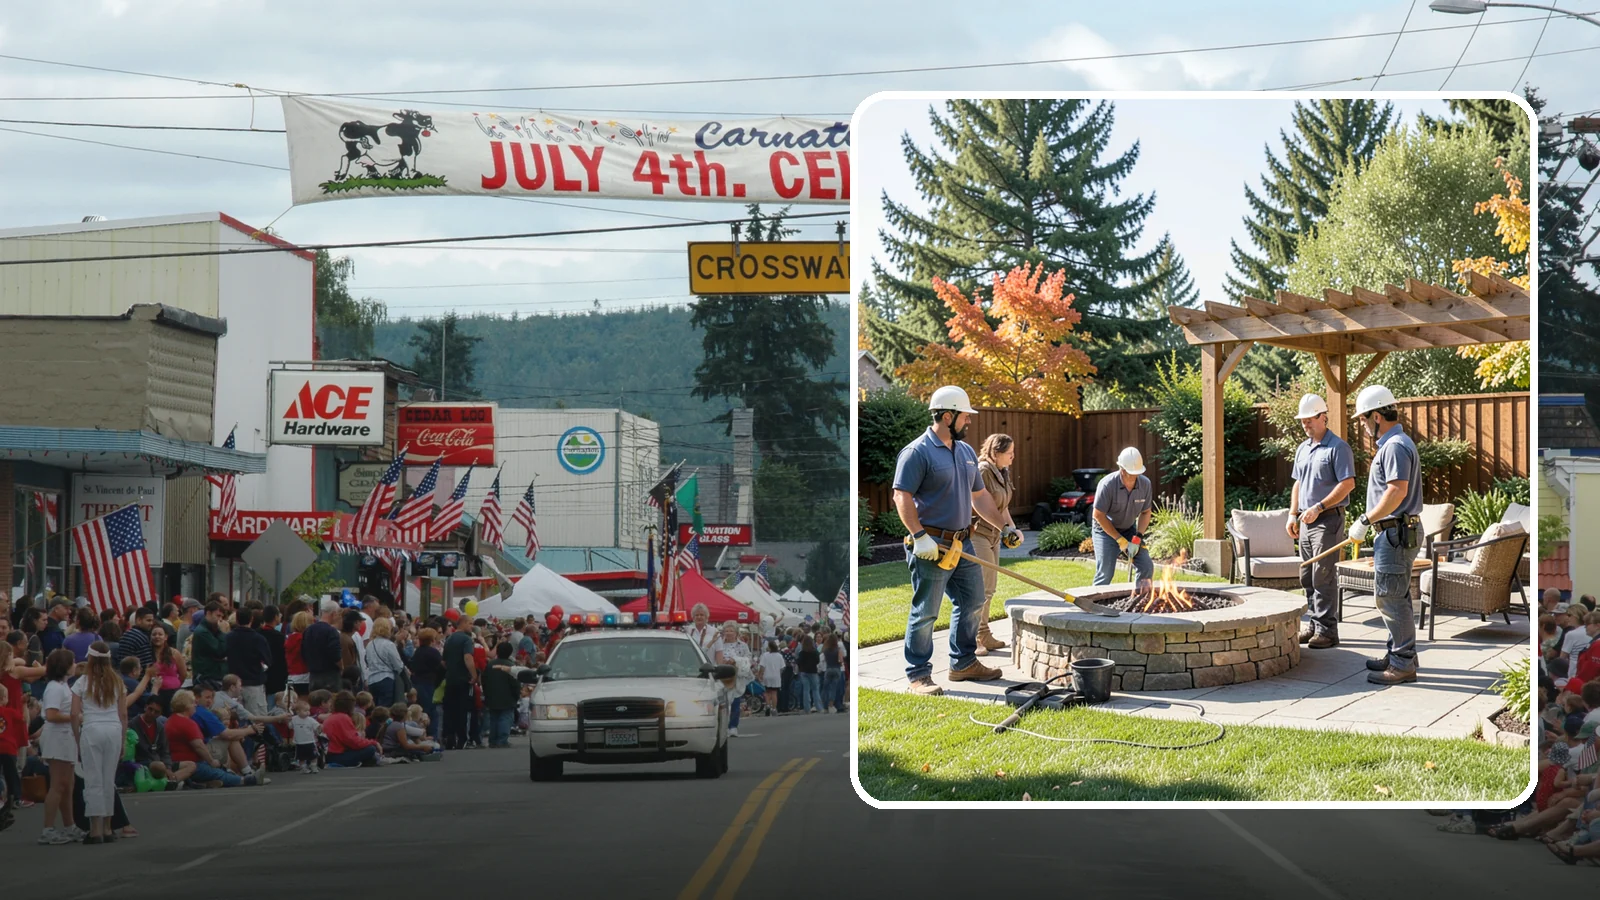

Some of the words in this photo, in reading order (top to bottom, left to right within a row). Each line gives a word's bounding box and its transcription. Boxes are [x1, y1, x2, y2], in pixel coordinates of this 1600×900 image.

[481, 140, 604, 192] JULY
[632, 150, 746, 198] 4th.
[697, 254, 850, 280] CROSSWA
[283, 380, 373, 420] ACE
[406, 409, 452, 422] CEDAR
[283, 421, 371, 436] Hardware
[416, 428, 477, 447] Coca-Cola
[95, 485, 124, 495] Vincent
[126, 486, 135, 495] de
[137, 486, 155, 495] Paul
[688, 526, 741, 535] CRNATION
[699, 535, 730, 543] GLASS
